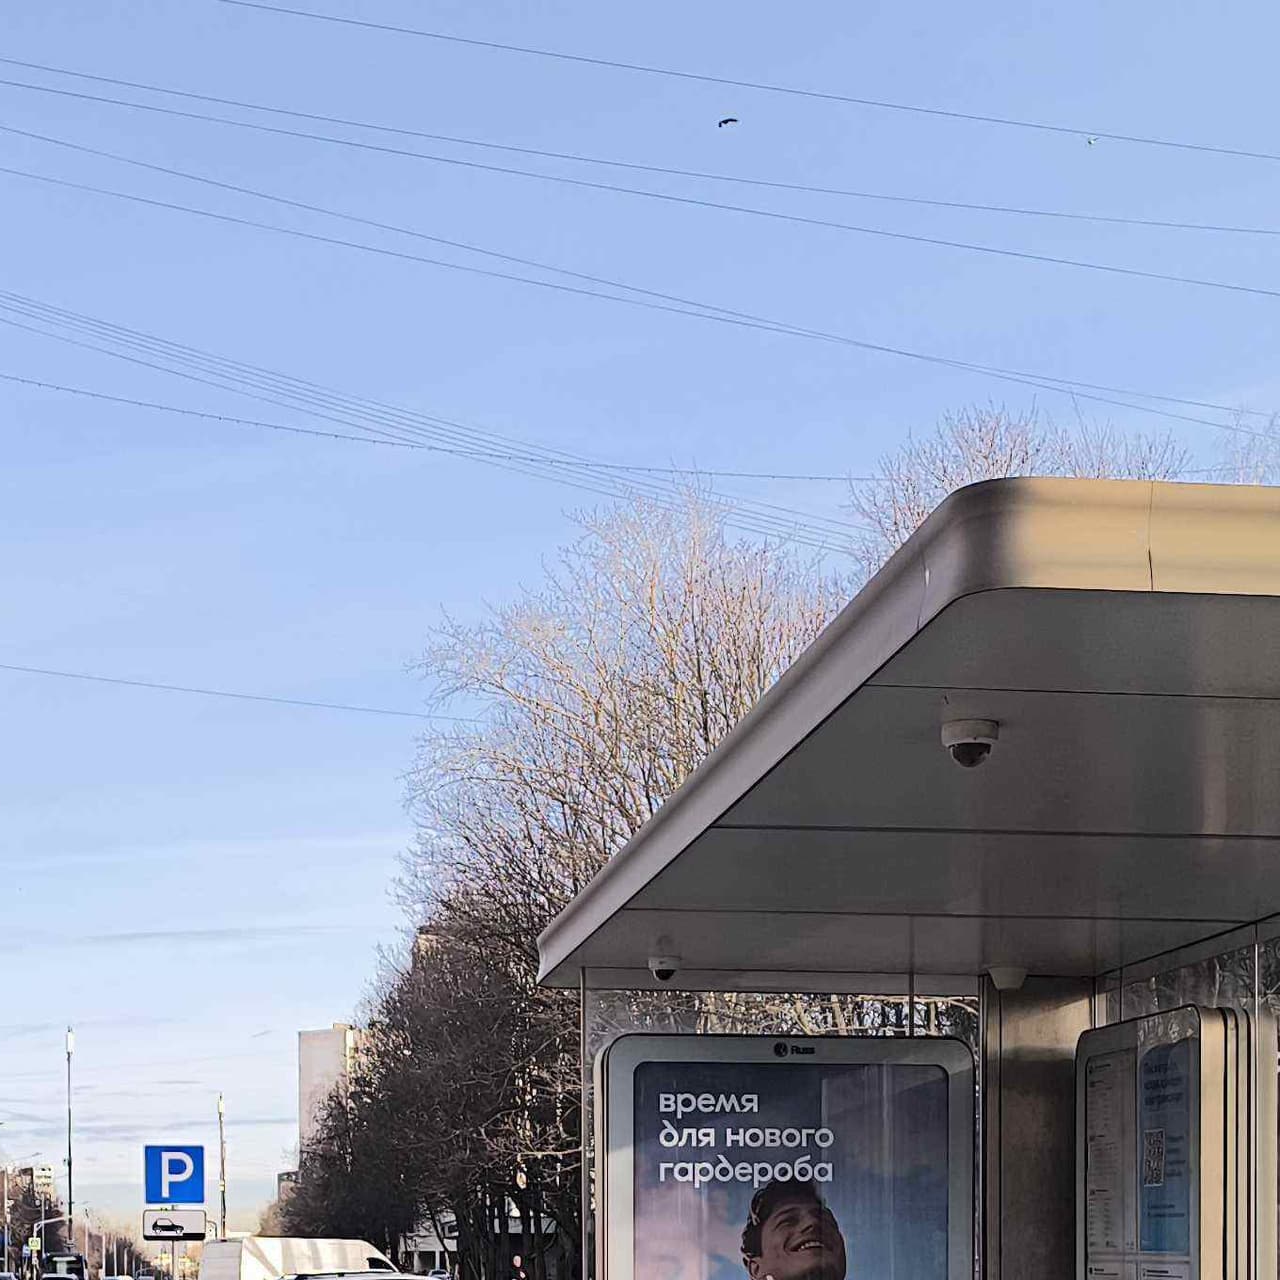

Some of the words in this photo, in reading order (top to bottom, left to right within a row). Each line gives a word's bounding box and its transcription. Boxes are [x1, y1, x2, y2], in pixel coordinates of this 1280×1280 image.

[658, 1091, 760, 1119] время
[658, 1119, 716, 1148] для
[725, 1127, 835, 1148] нового
[161, 1151, 194, 1198] P
[658, 1153, 833, 1189] гардероба
